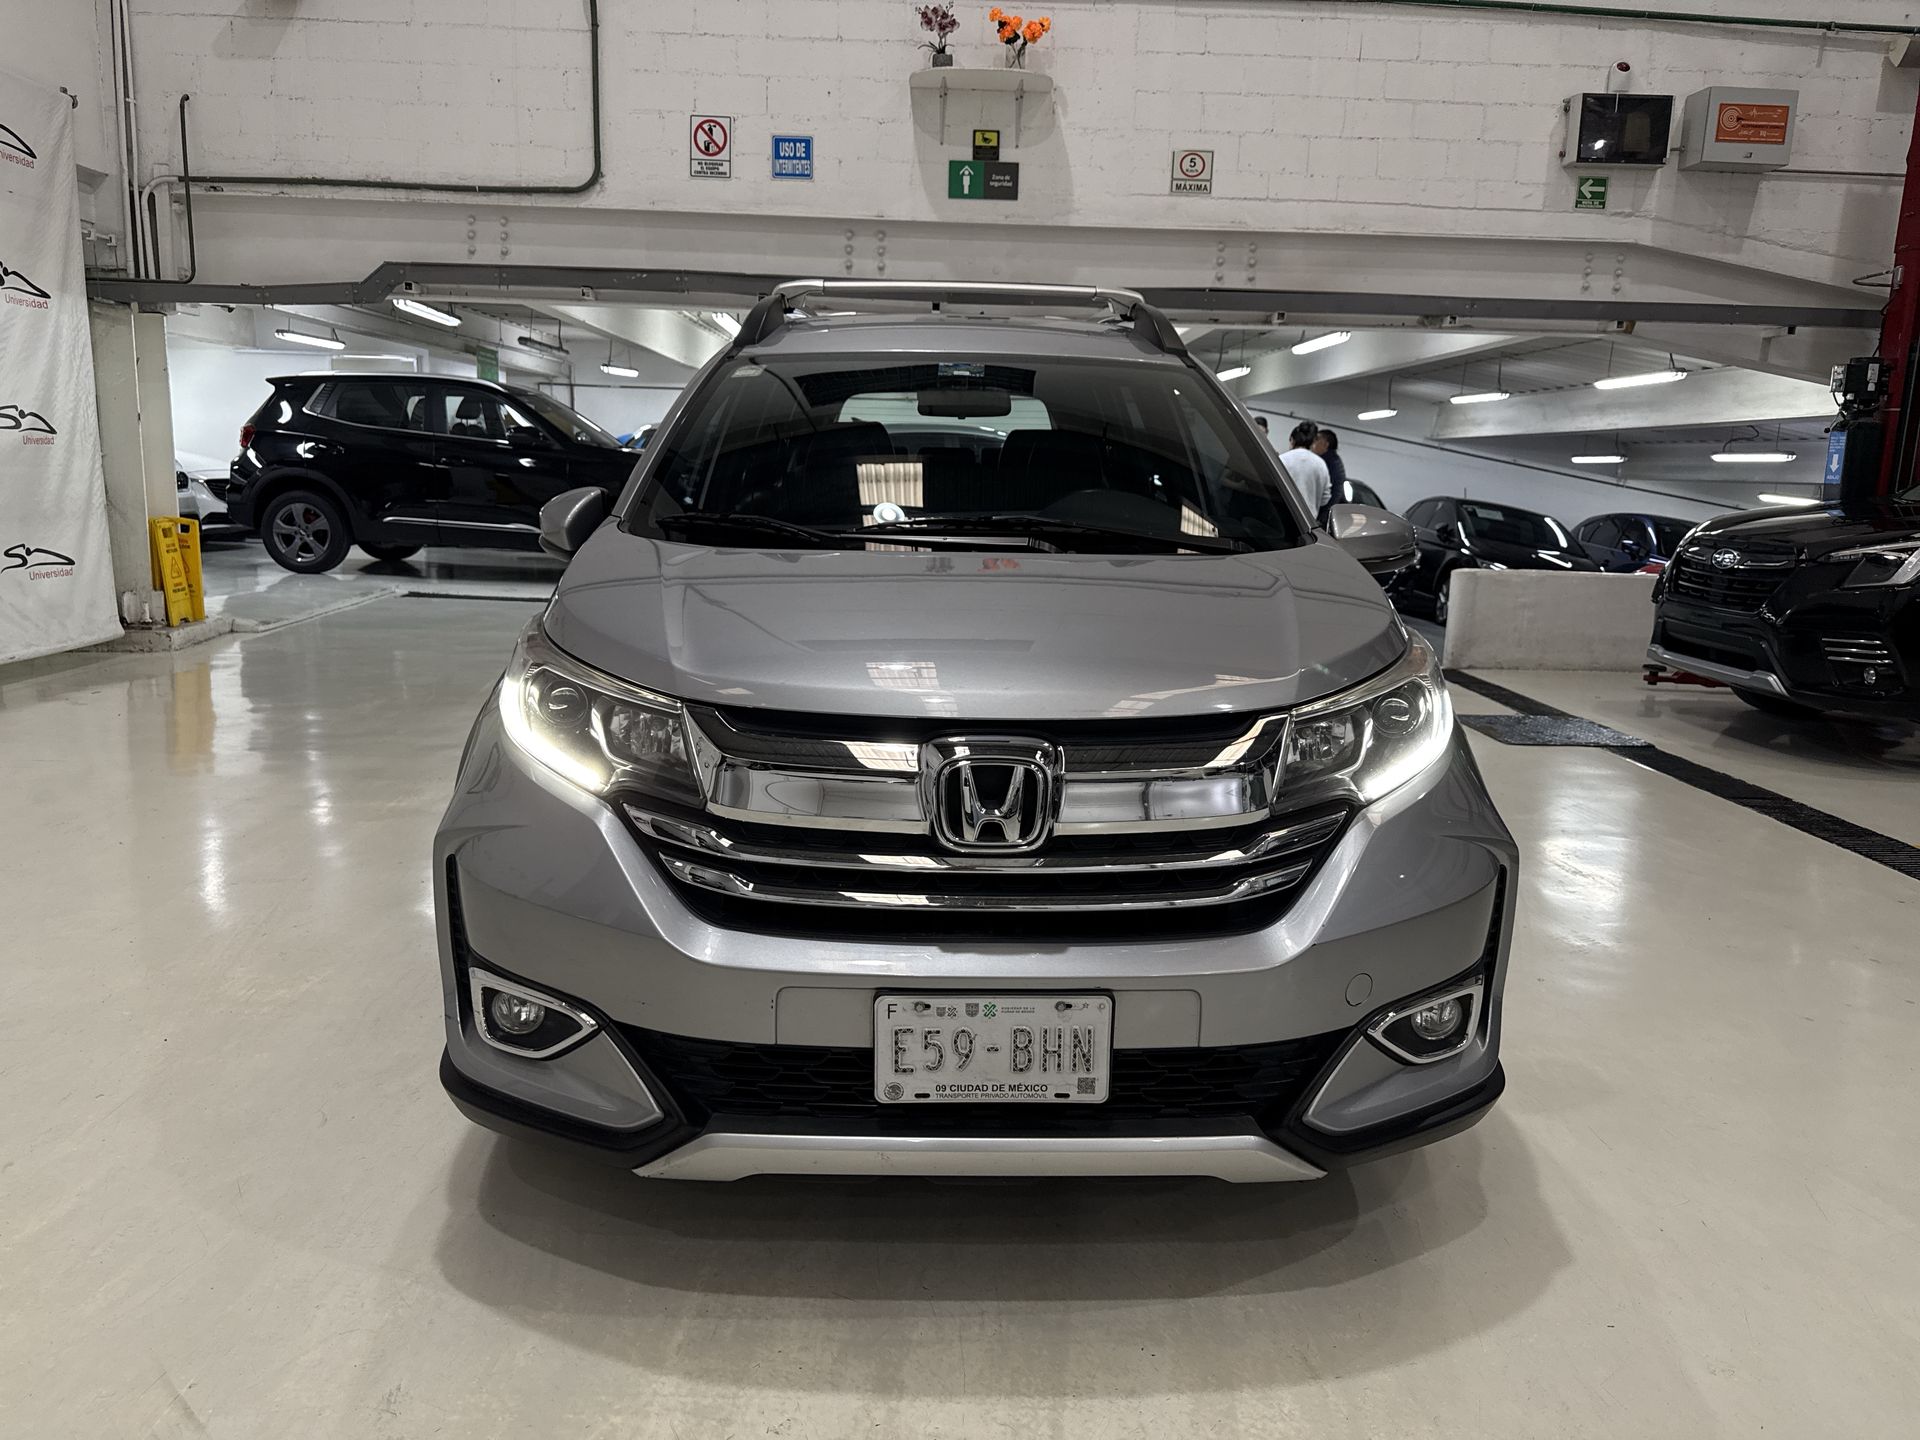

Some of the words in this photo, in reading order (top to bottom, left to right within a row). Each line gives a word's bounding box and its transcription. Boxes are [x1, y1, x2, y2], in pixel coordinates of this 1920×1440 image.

[779, 141, 795, 157] USO
[796, 142, 806, 158] DE
[1189, 157, 1197, 168] 5
[4, 293, 49, 309] Universidad
[22, 434, 55, 446] Universidad
[29, 566, 74, 581] Universidad
[887, 1003, 898, 1019] F
[935, 1084, 947, 1092] 09
[949, 1084, 989, 1092] CIUDAD
[991, 1084, 1006, 1092] DE
[1008, 1082, 1048, 1092] MÉXICO
